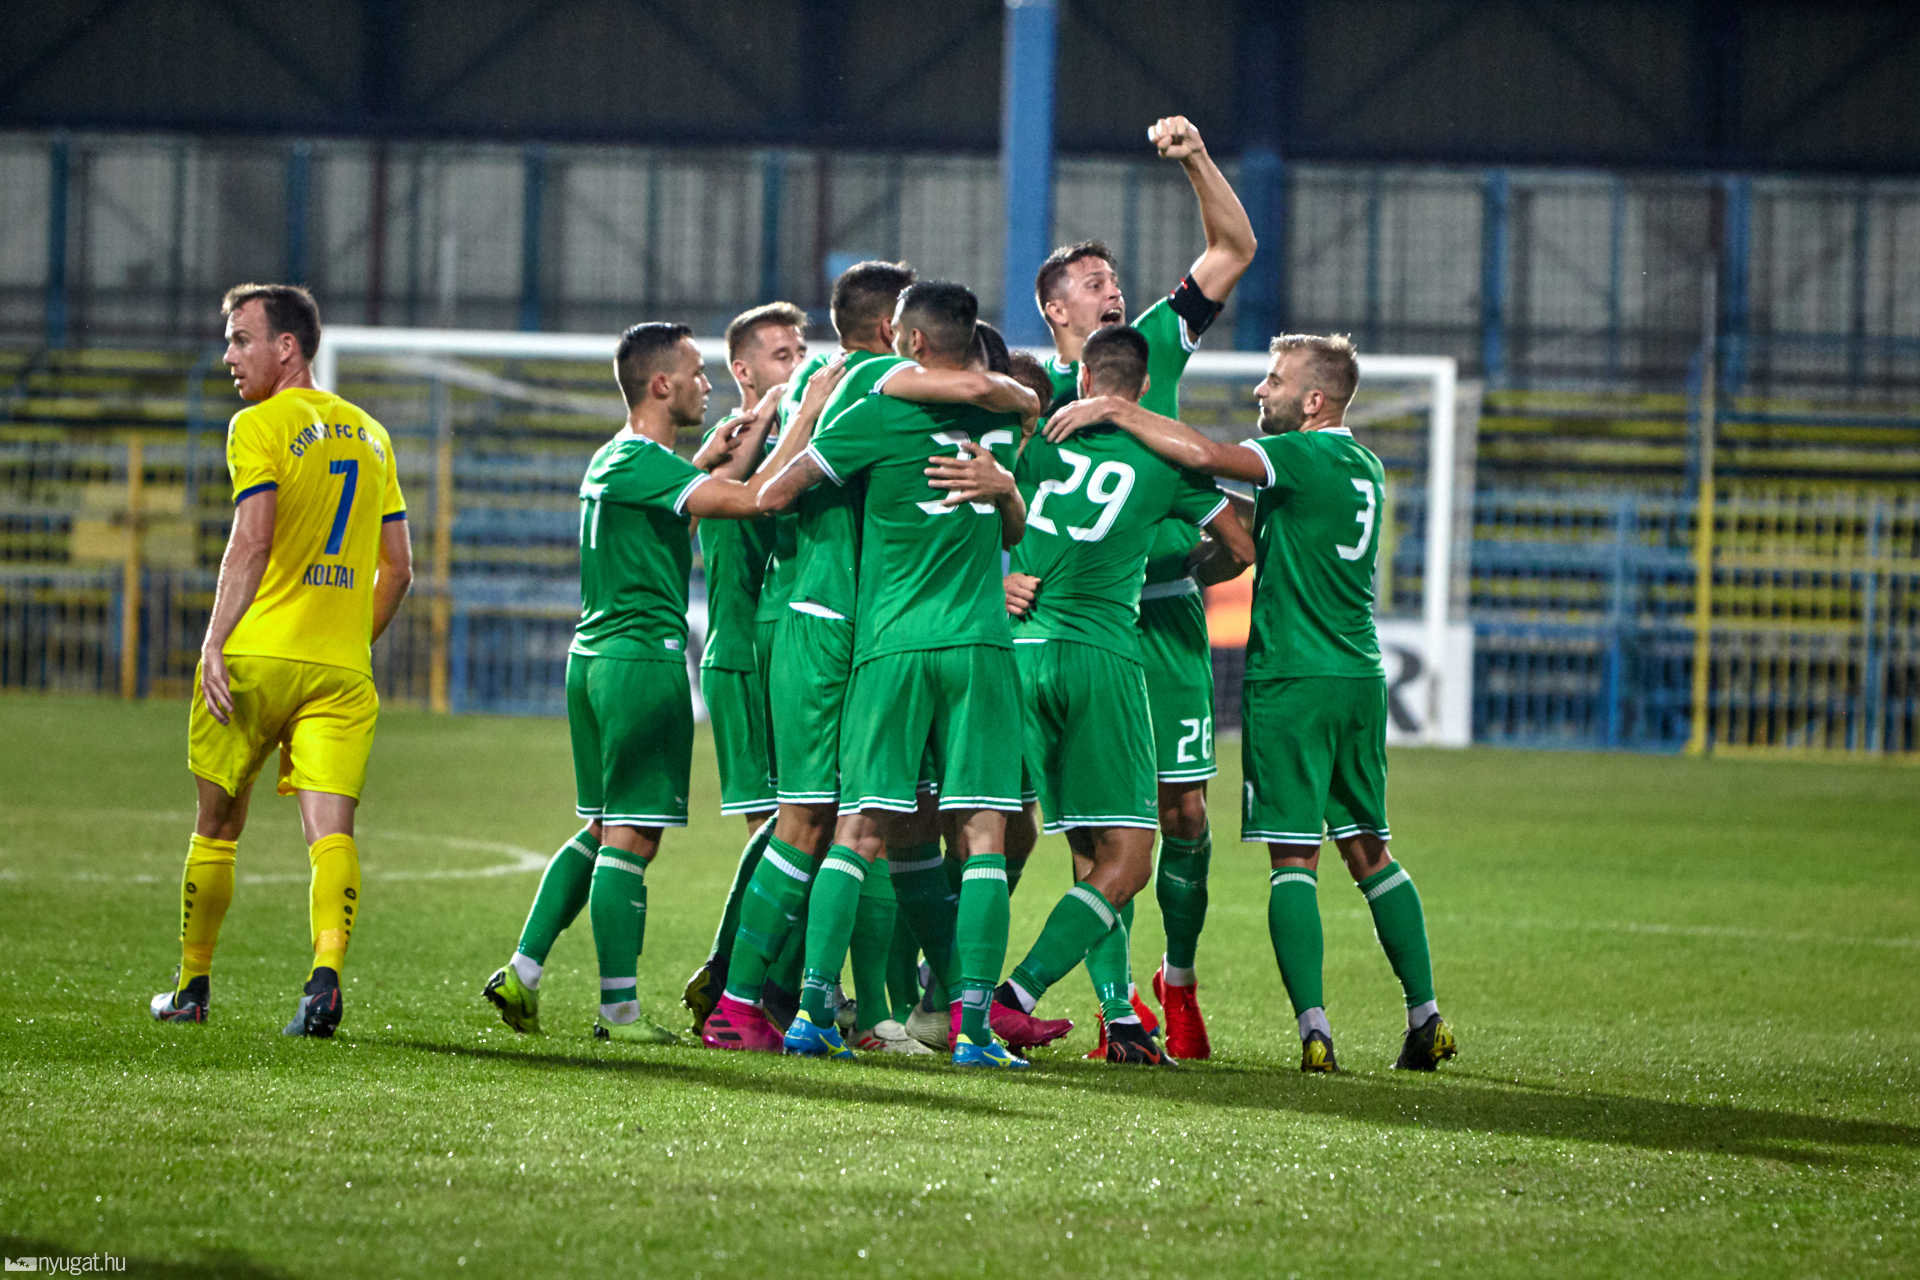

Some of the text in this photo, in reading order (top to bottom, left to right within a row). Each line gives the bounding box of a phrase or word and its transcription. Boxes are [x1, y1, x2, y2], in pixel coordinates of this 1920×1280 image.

[335, 424, 353, 438] FC
[325, 459, 358, 555] 7
[1026, 448, 1136, 542] 29
[302, 563, 354, 589] KOLTAI
